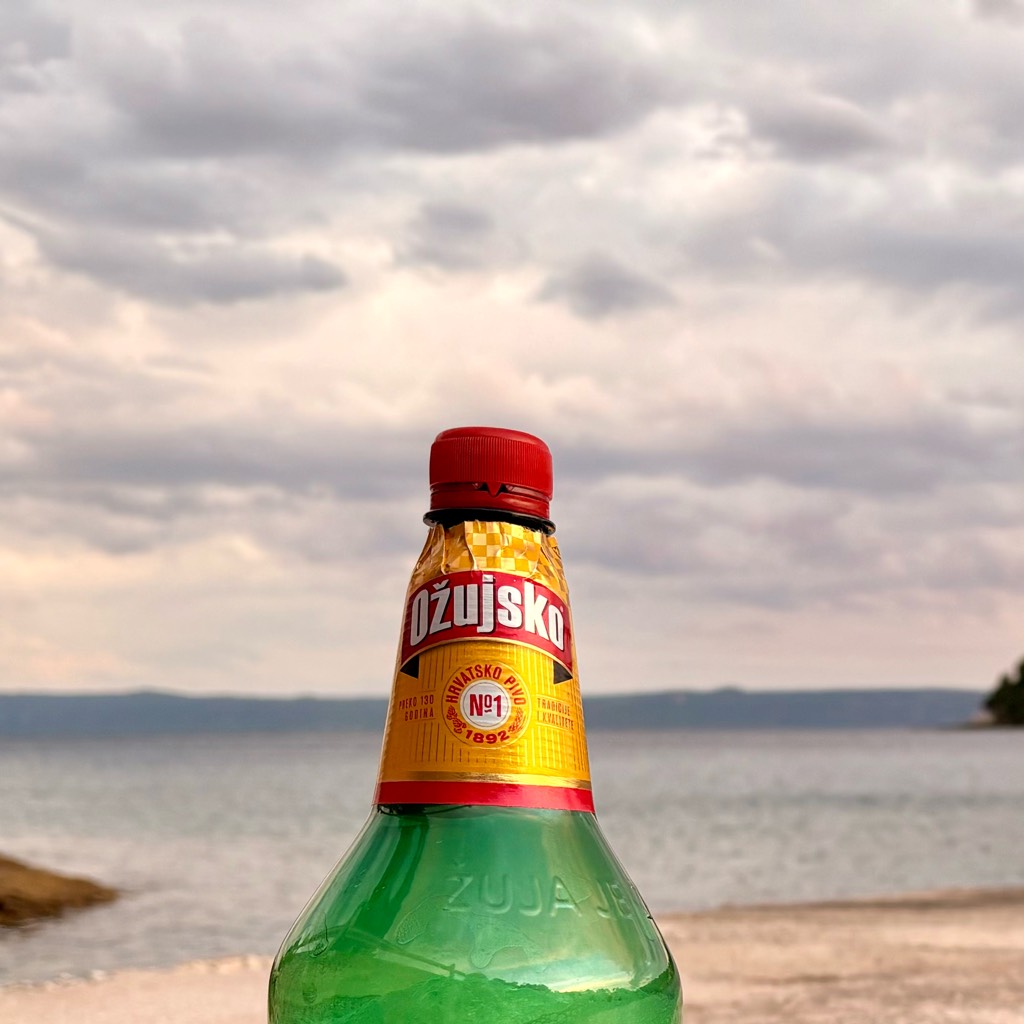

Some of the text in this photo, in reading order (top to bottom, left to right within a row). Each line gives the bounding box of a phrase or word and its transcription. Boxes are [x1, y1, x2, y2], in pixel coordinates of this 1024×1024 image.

[410, 574, 564, 651] Ožujsko
[445, 663, 526, 705] HRVATSKO PIVO
[420, 694, 434, 706] 130
[465, 729, 510, 744] 1892
